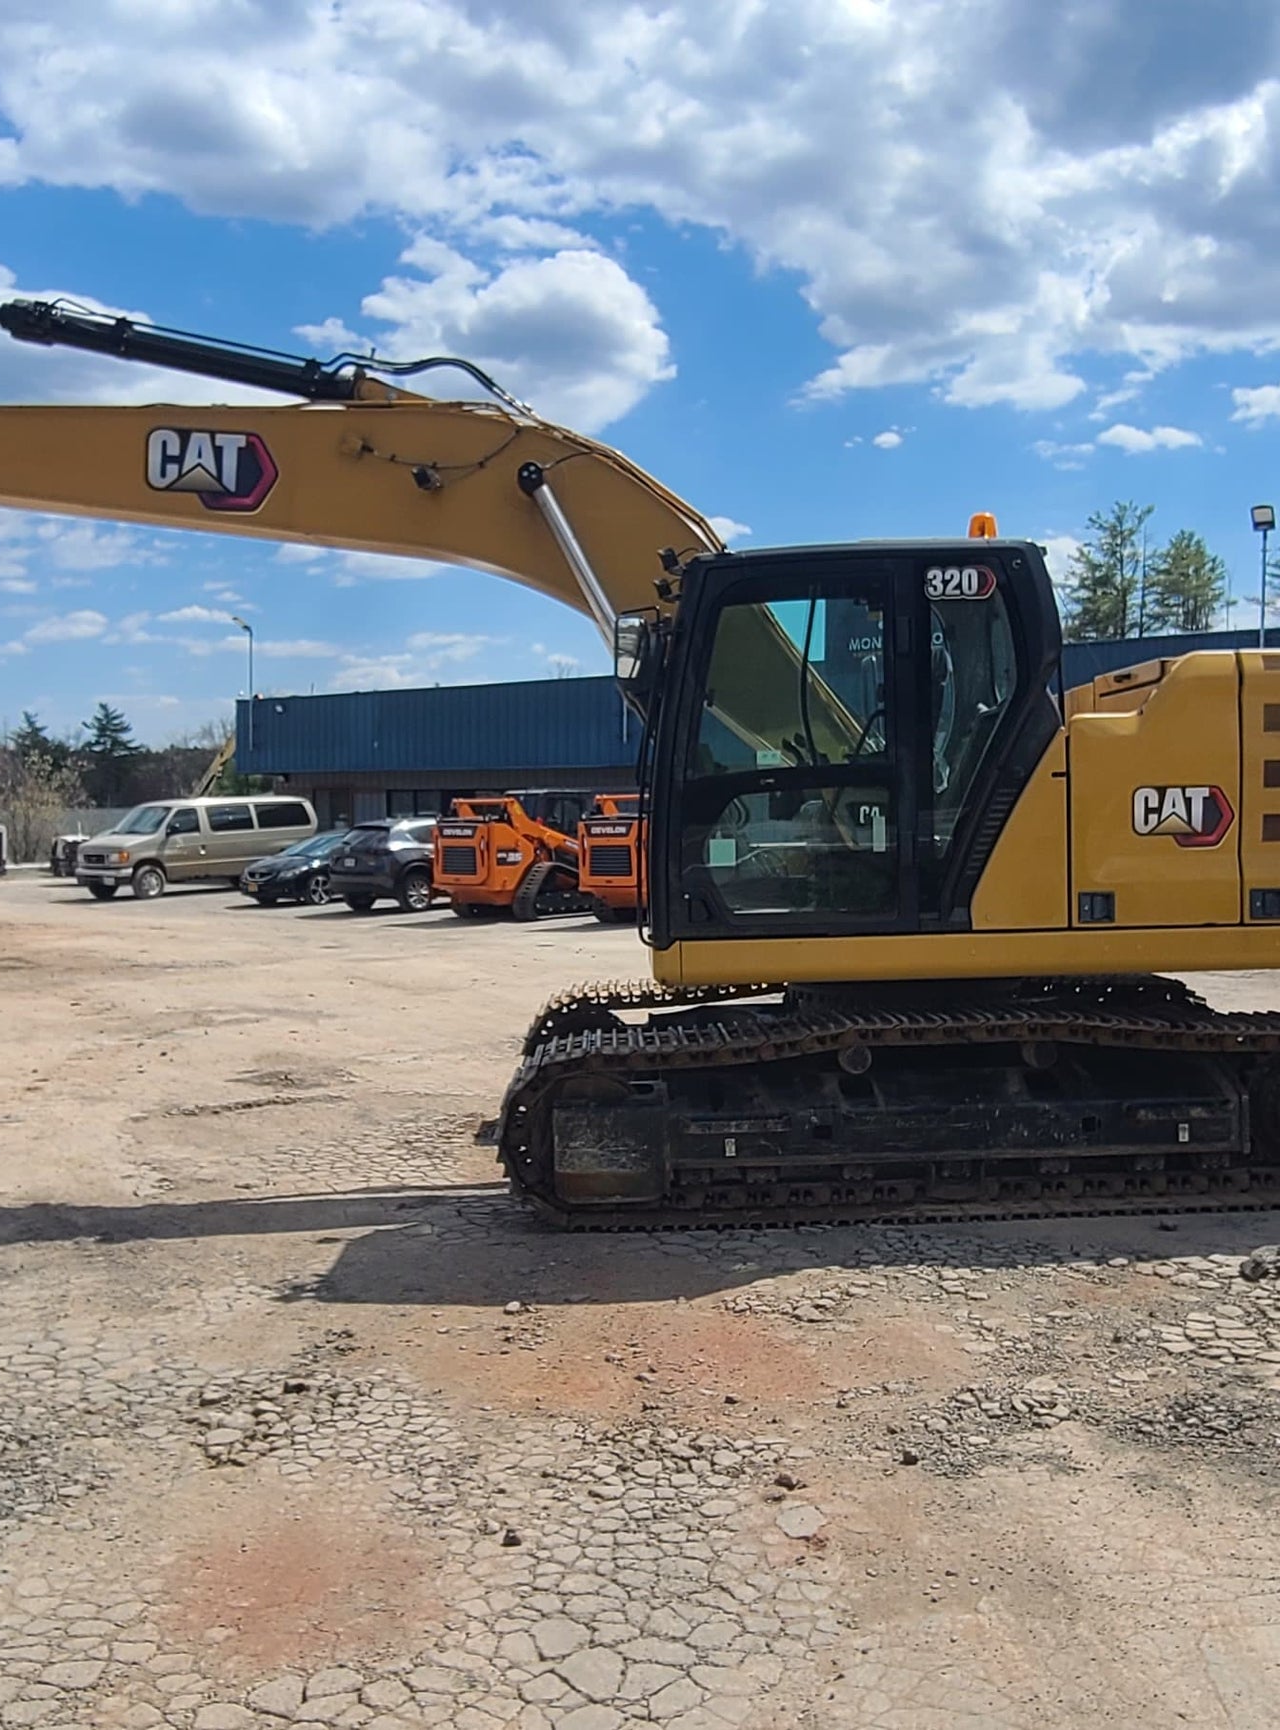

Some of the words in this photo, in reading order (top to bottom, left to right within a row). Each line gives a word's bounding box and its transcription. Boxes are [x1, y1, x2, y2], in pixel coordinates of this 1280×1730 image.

[147, 429, 247, 493] CAT
[926, 569, 979, 596] 320
[1133, 787, 1210, 834] CAT
